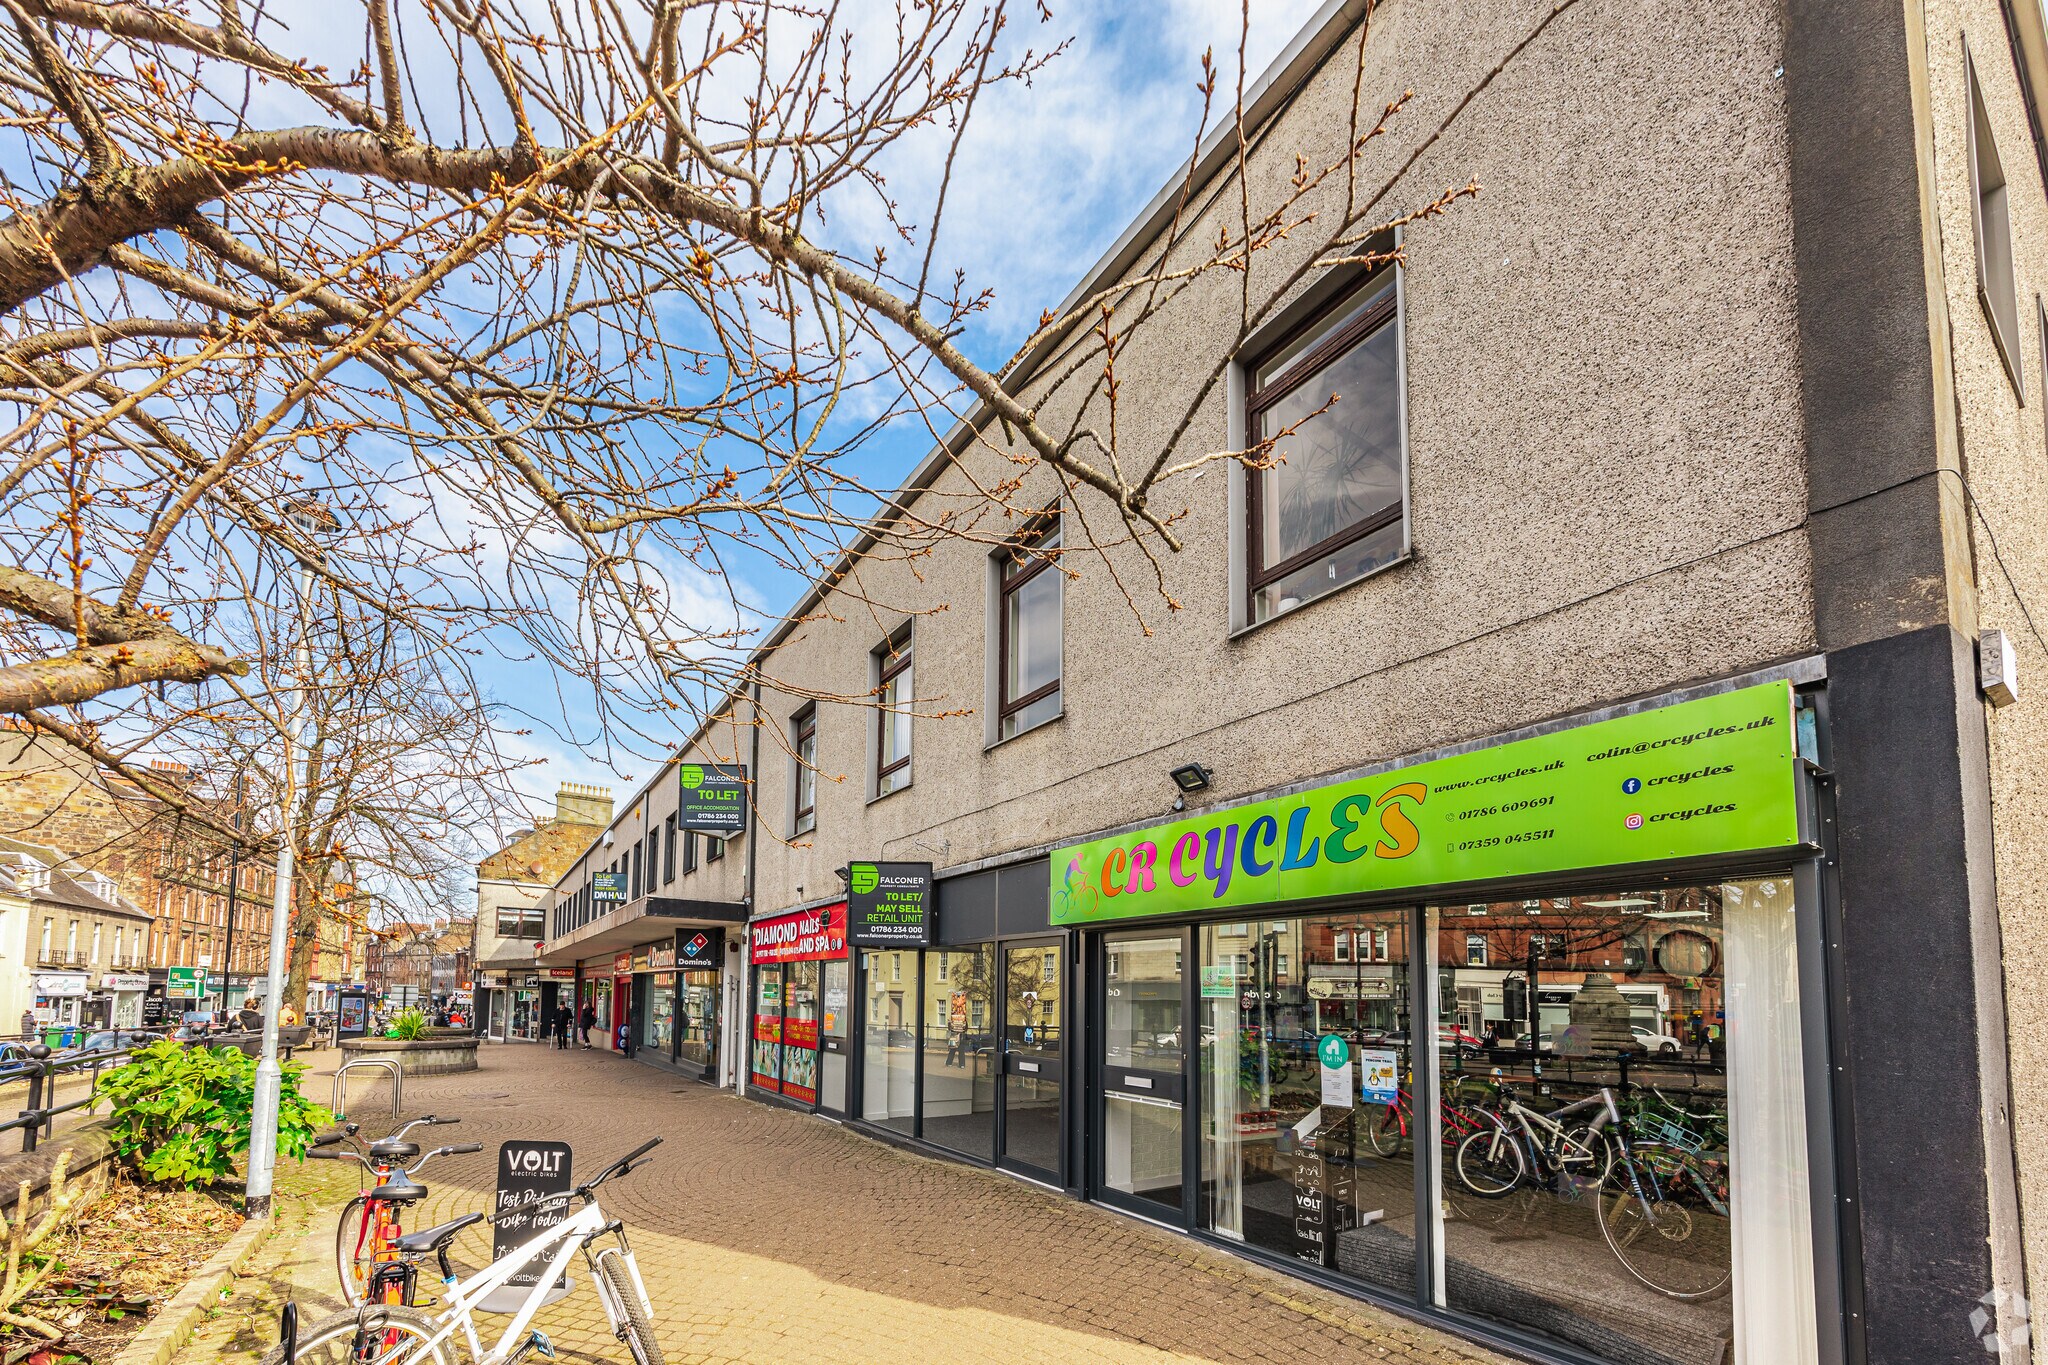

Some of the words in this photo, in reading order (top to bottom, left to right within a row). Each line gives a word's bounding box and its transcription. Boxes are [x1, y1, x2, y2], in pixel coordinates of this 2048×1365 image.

[1586, 715, 1777, 763] colin@crcycles.uk
[1434, 759, 1566, 794] www.crcycles.uk
[1647, 764, 1736, 787] crcycles
[697, 789, 715, 800] TO
[716, 790, 740, 800] LET
[1458, 805, 1498, 821] 01786
[1501, 795, 1556, 813] 609691
[1649, 803, 1738, 823] crcycles
[1100, 841, 1158, 898] CR
[1168, 782, 1428, 899] CYCLES
[1458, 837, 1500, 851] 07359
[1504, 829, 1556, 845] 045511
[880, 876, 924, 884] FALCONER
[594, 891, 607, 899] DM
[885, 892, 899, 901] TO
[900, 892, 923, 902] LET/
[876, 904, 898, 913] MAY
[898, 904, 923, 913] SELL
[866, 913, 899, 922] RETAIL
[901, 914, 924, 923] UNIT
[755, 921, 798, 946] DIAMOND
[799, 917, 820, 936] NAILS
[870, 925, 892, 933] 01786
[799, 937, 815, 954] AND
[815, 935, 830, 952] SPA
[678, 958, 712, 966] Domino's
[551, 969, 574, 977] Iceland
[1322, 1054, 1334, 1063] I'M
[1334, 1055, 1343, 1063] IN
[507, 1150, 564, 1172] VOLT
[497, 1189, 522, 1208] Test
[1295, 1194, 1321, 1210] VOLT
